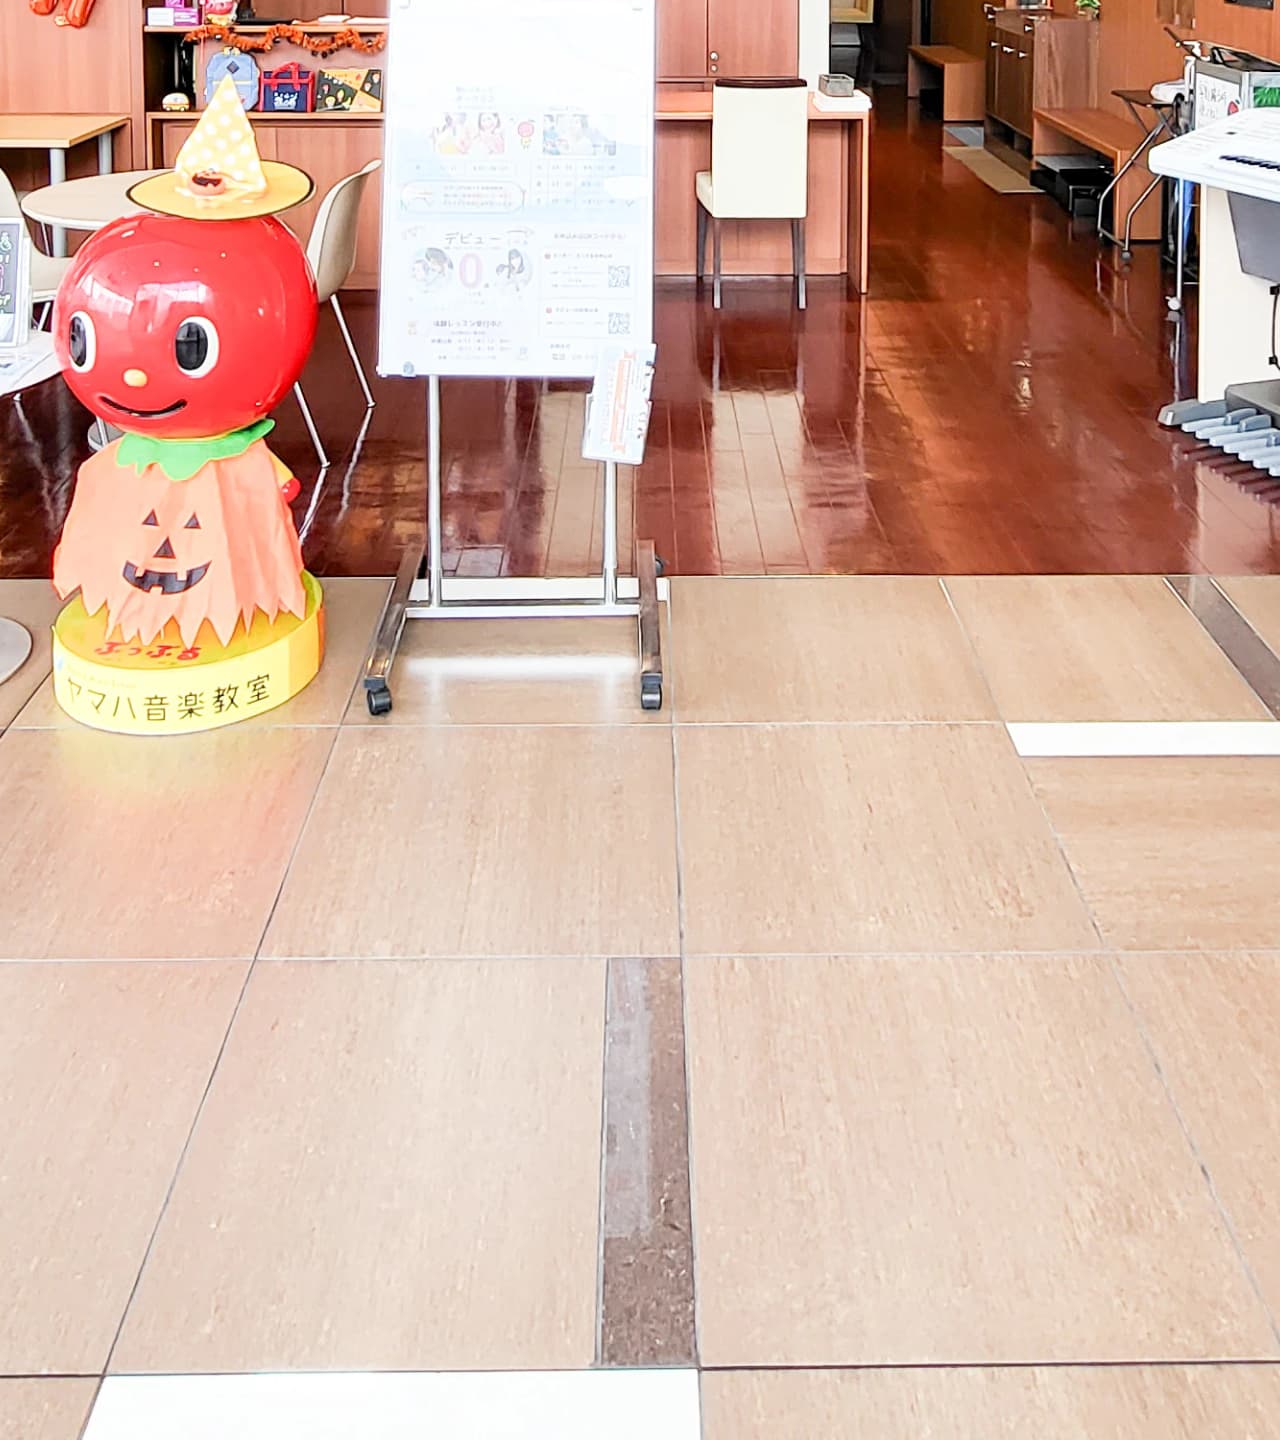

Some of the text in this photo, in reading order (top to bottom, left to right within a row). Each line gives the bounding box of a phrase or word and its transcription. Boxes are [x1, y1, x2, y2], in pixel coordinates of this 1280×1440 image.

[444, 231, 502, 246] デビュー
[66, 672, 270, 722] ヤマハ音楽教室
